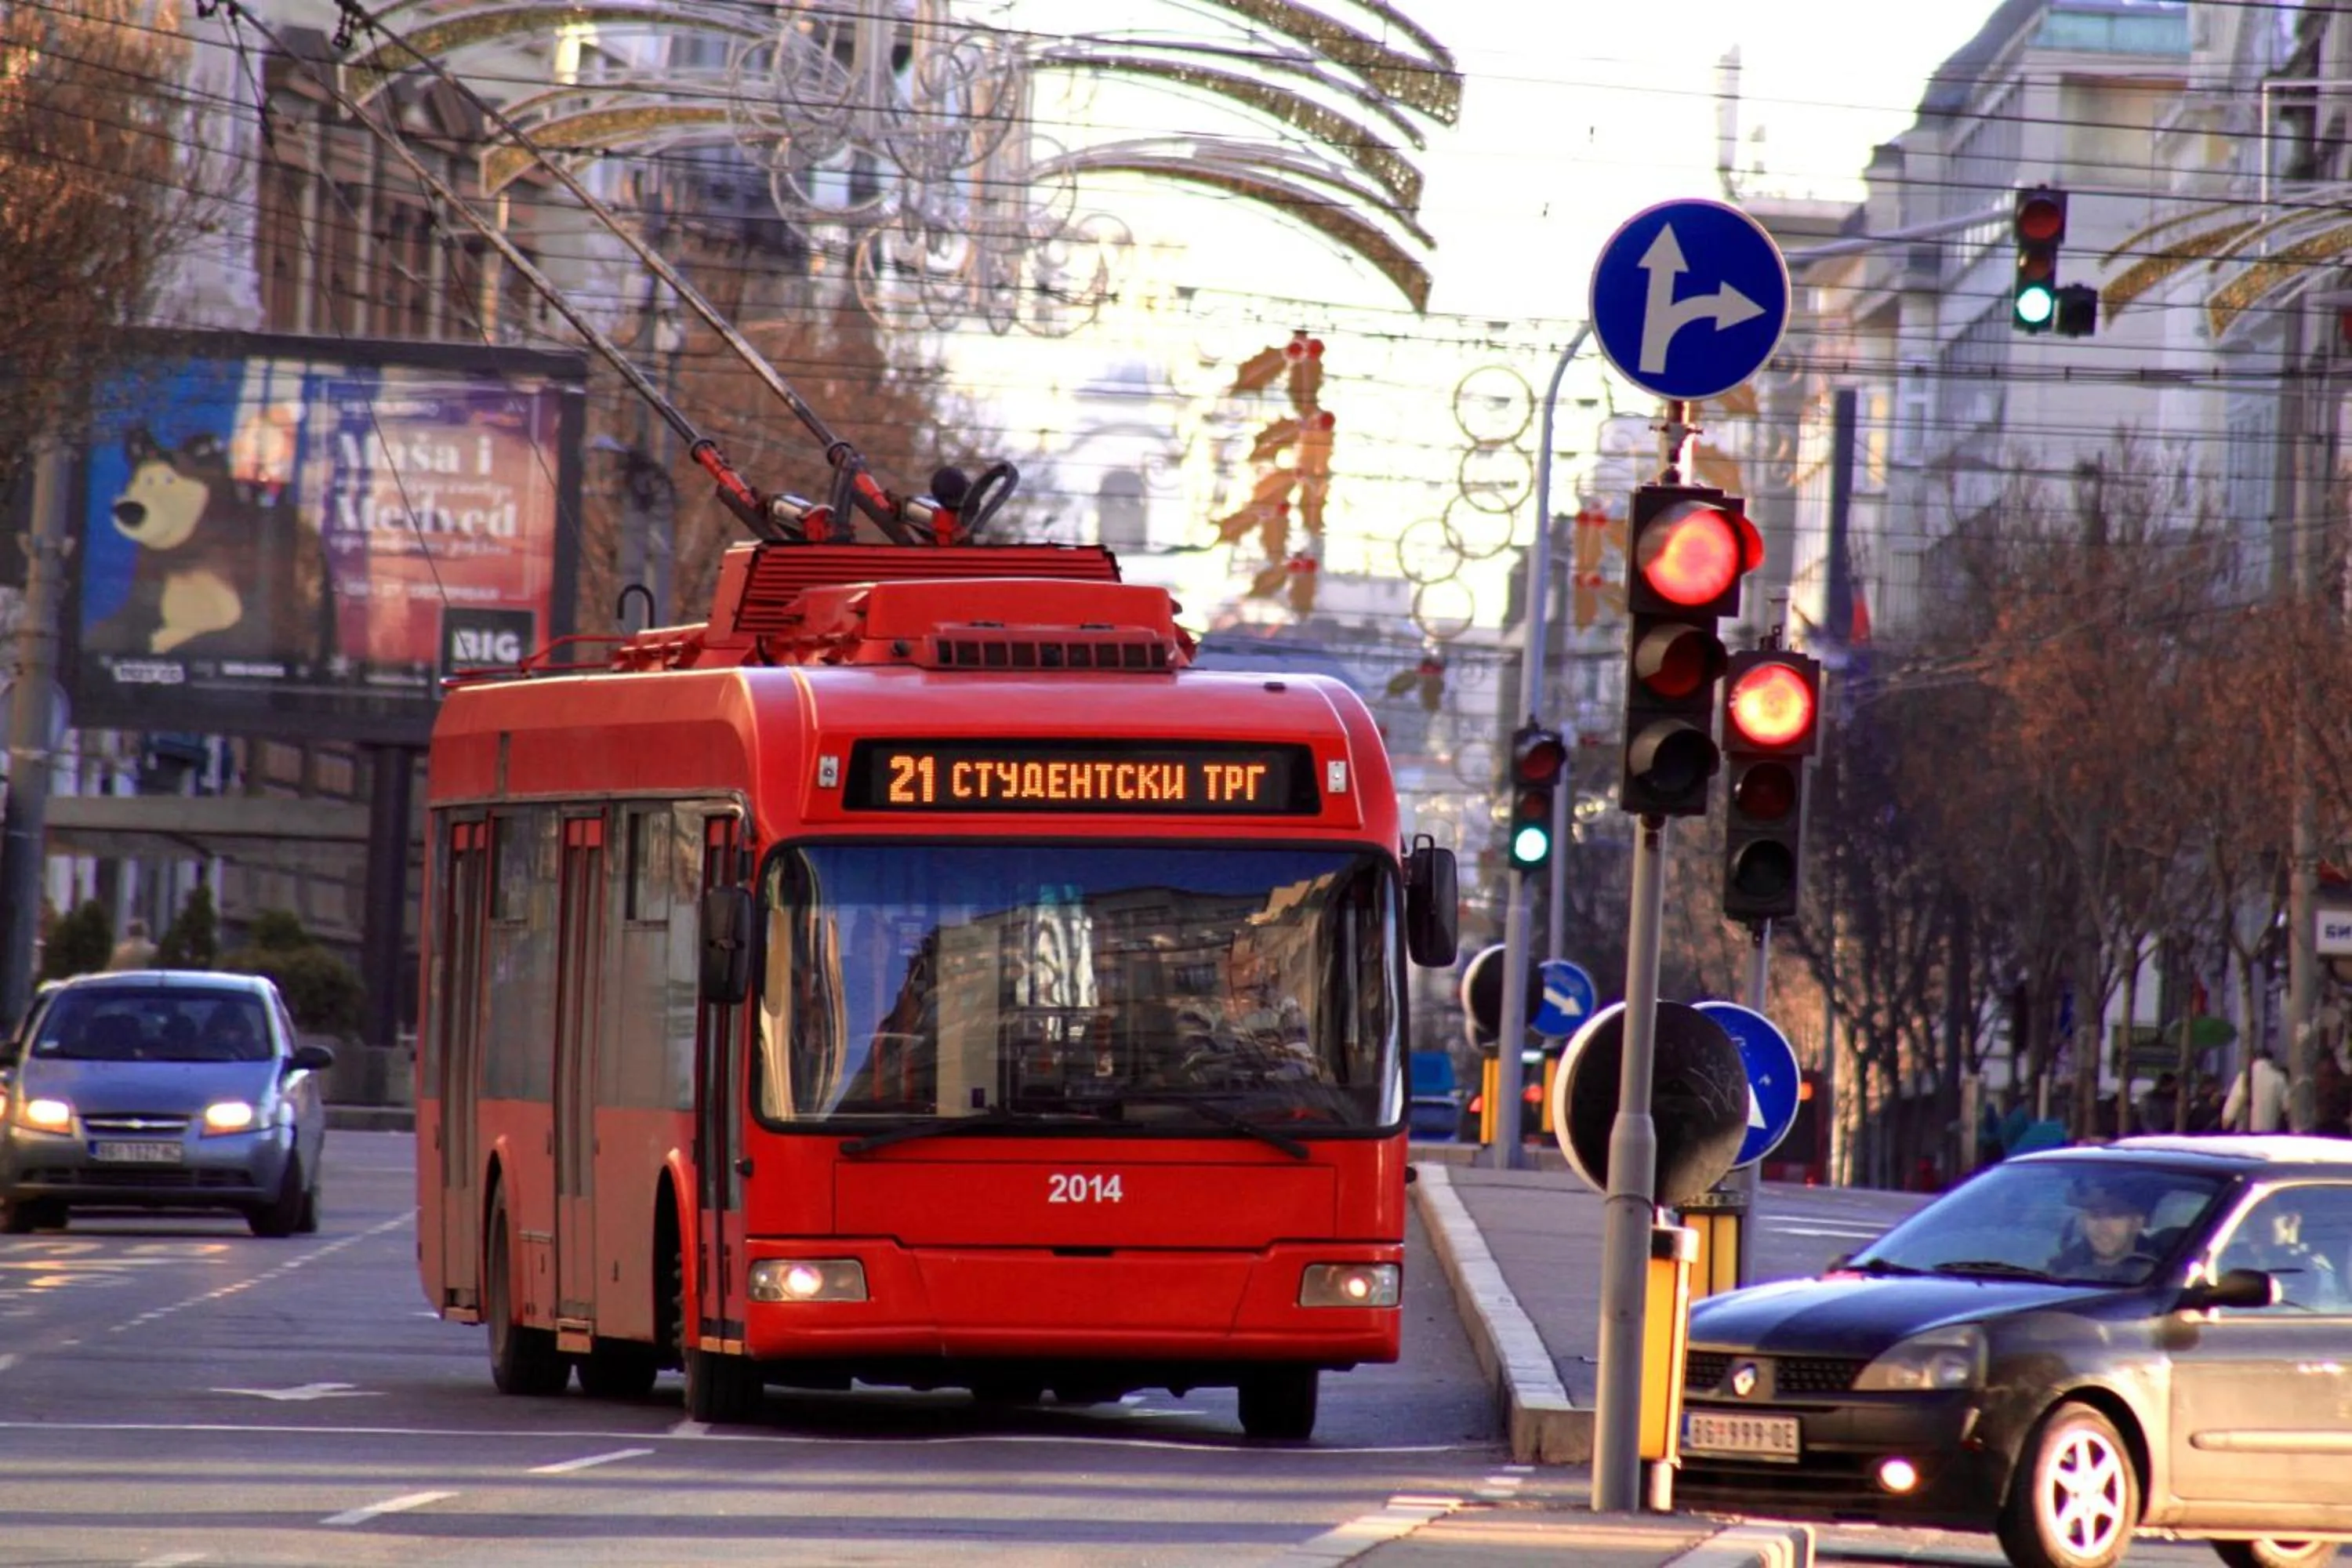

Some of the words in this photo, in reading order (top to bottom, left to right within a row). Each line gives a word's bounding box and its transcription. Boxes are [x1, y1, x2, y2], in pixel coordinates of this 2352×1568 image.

[339, 430, 461, 474] Maša
[477, 434, 493, 475] i
[336, 494, 517, 538] Medved
[452, 629, 521, 663] BIG
[890, 755, 935, 803] 21
[953, 761, 1184, 800] СТУДЕНТСКИ
[1203, 765, 1265, 800] ТРГ
[1047, 1174, 1123, 1203] 2014
